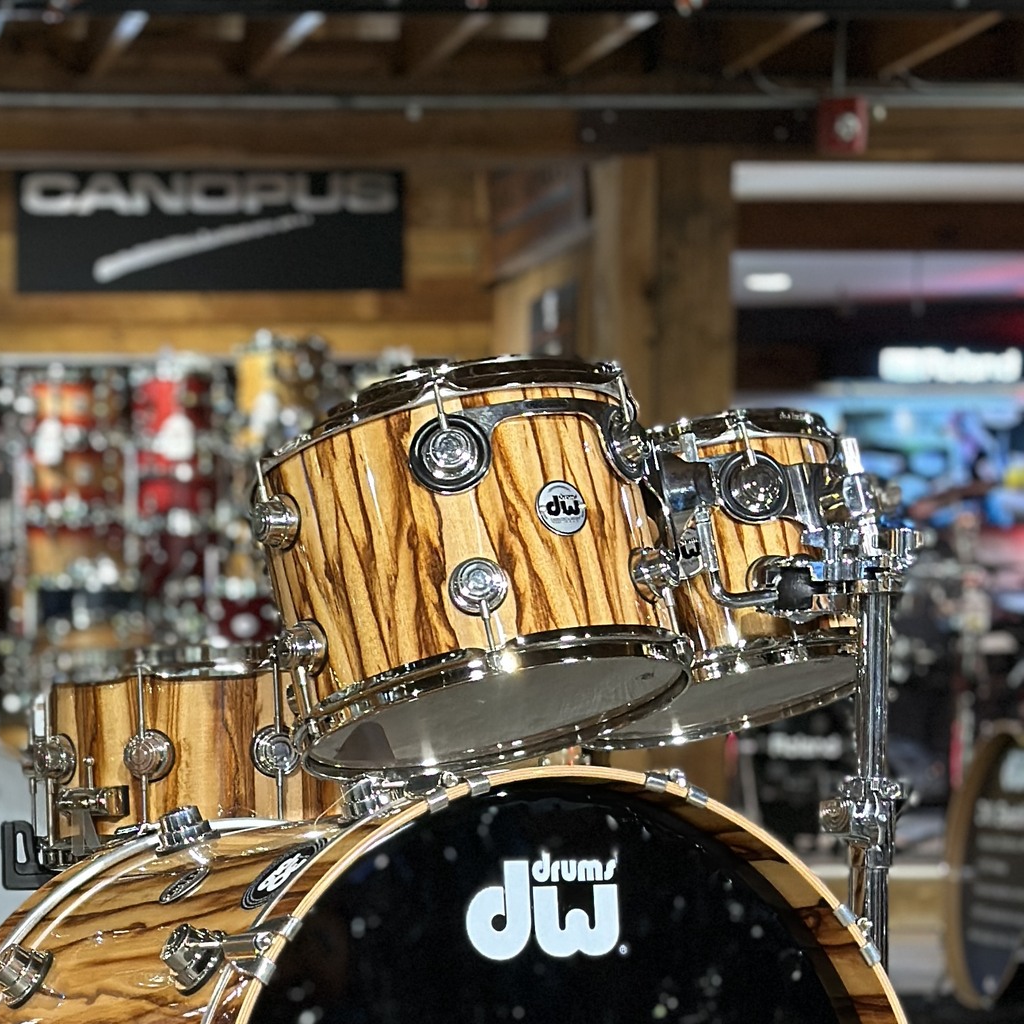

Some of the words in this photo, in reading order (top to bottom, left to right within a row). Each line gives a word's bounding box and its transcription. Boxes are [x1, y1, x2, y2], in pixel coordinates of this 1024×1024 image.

[21, 172, 398, 216] CANOPUS
[546, 495, 580, 516] dw
[532, 850, 619, 882] drums
[466, 861, 620, 961] dw
